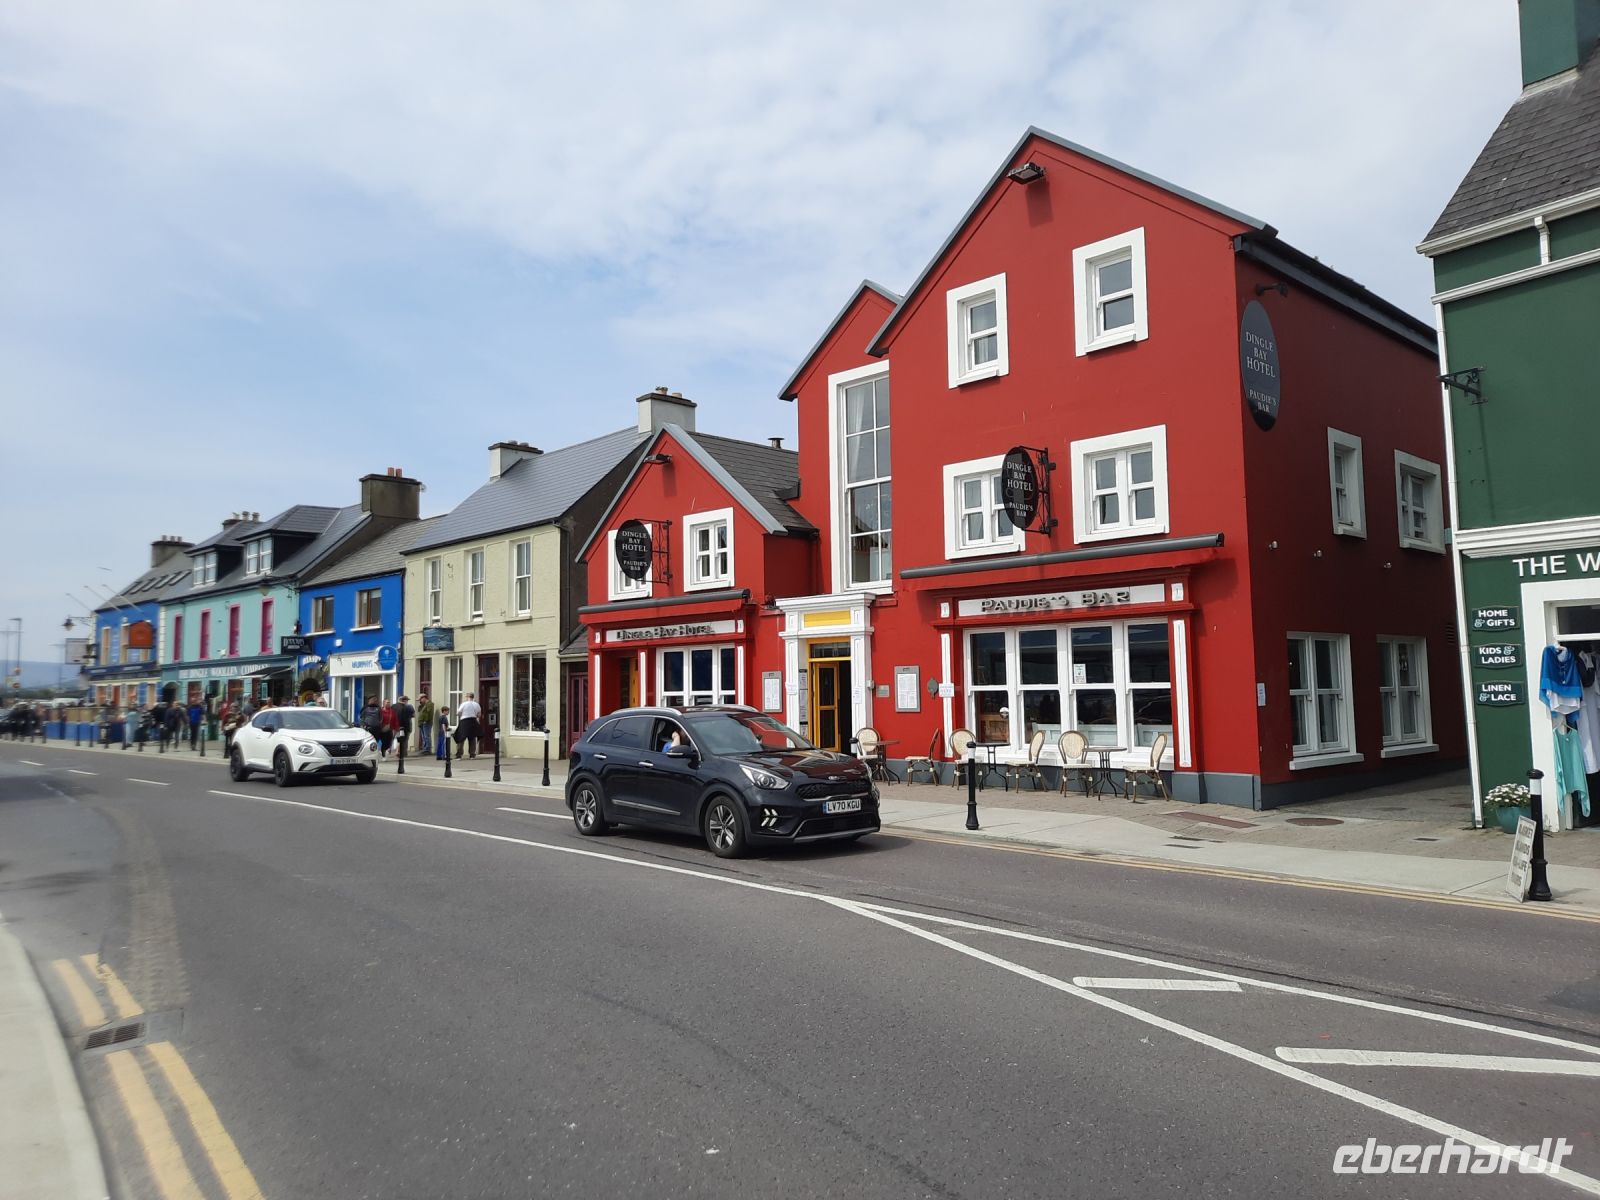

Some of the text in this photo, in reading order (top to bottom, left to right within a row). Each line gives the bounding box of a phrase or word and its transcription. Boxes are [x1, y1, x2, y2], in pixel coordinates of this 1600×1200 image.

[1245, 331, 1274, 352] DINGLE
[1253, 347, 1268, 361] BAY
[1246, 356, 1276, 378] HOTEL
[1249, 389, 1277, 406] PAUDIE'S
[1257, 402, 1270, 413] BAR
[1006, 461, 1032, 473] DINGLE
[1013, 472, 1026, 480] BAY
[1007, 479, 1033, 492] HOTEL
[1009, 501, 1034, 511] PAUDIE'S
[622, 531, 648, 539] DINGLE
[621, 543, 649, 552] HOTEL
[1512, 554, 1567, 577] THE
[981, 591, 1131, 613] PAUDIE'S BAR
[1478, 609, 1508, 618] HOME
[1474, 618, 1516, 628] & GIFTS
[1479, 645, 1515, 655] KIDS &
[1481, 656, 1516, 664] LADIES
[1481, 683, 1512, 692] LINEN
[1479, 693, 1517, 702] & LACE
[827, 800, 860, 812] LV70 KGU
